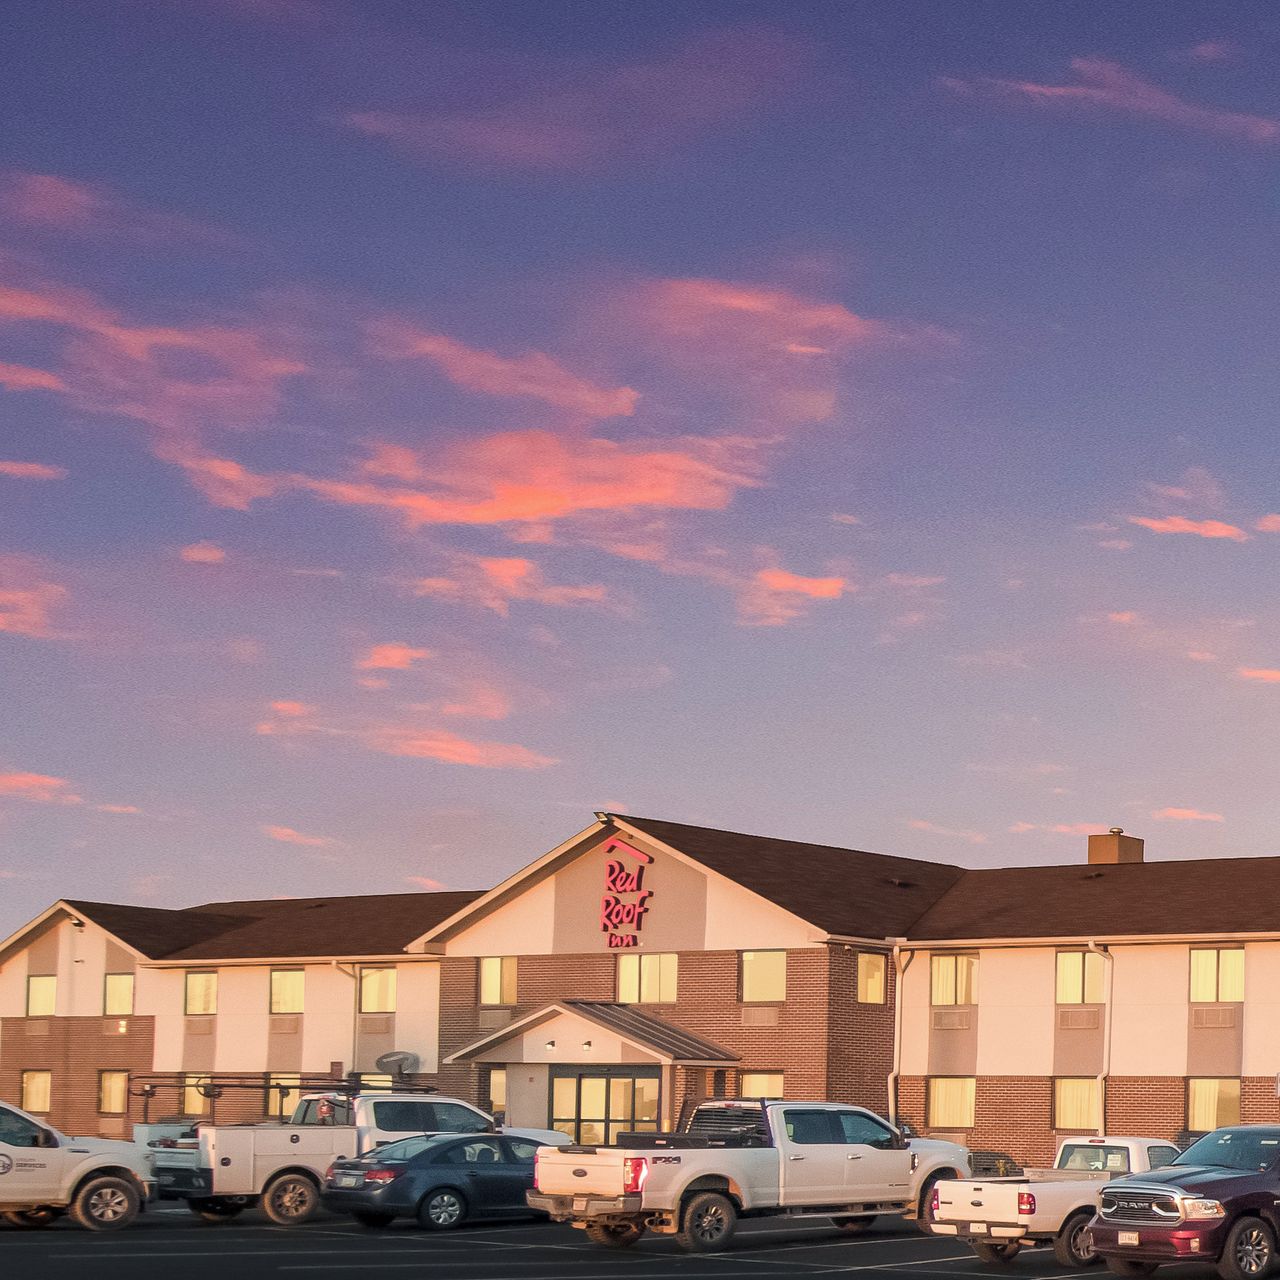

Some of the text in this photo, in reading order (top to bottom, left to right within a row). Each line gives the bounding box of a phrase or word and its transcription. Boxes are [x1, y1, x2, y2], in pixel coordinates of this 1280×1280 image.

[604, 860, 645, 893] Red
[600, 890, 654, 932] Roof
[1118, 1201, 1149, 1209] RAM
